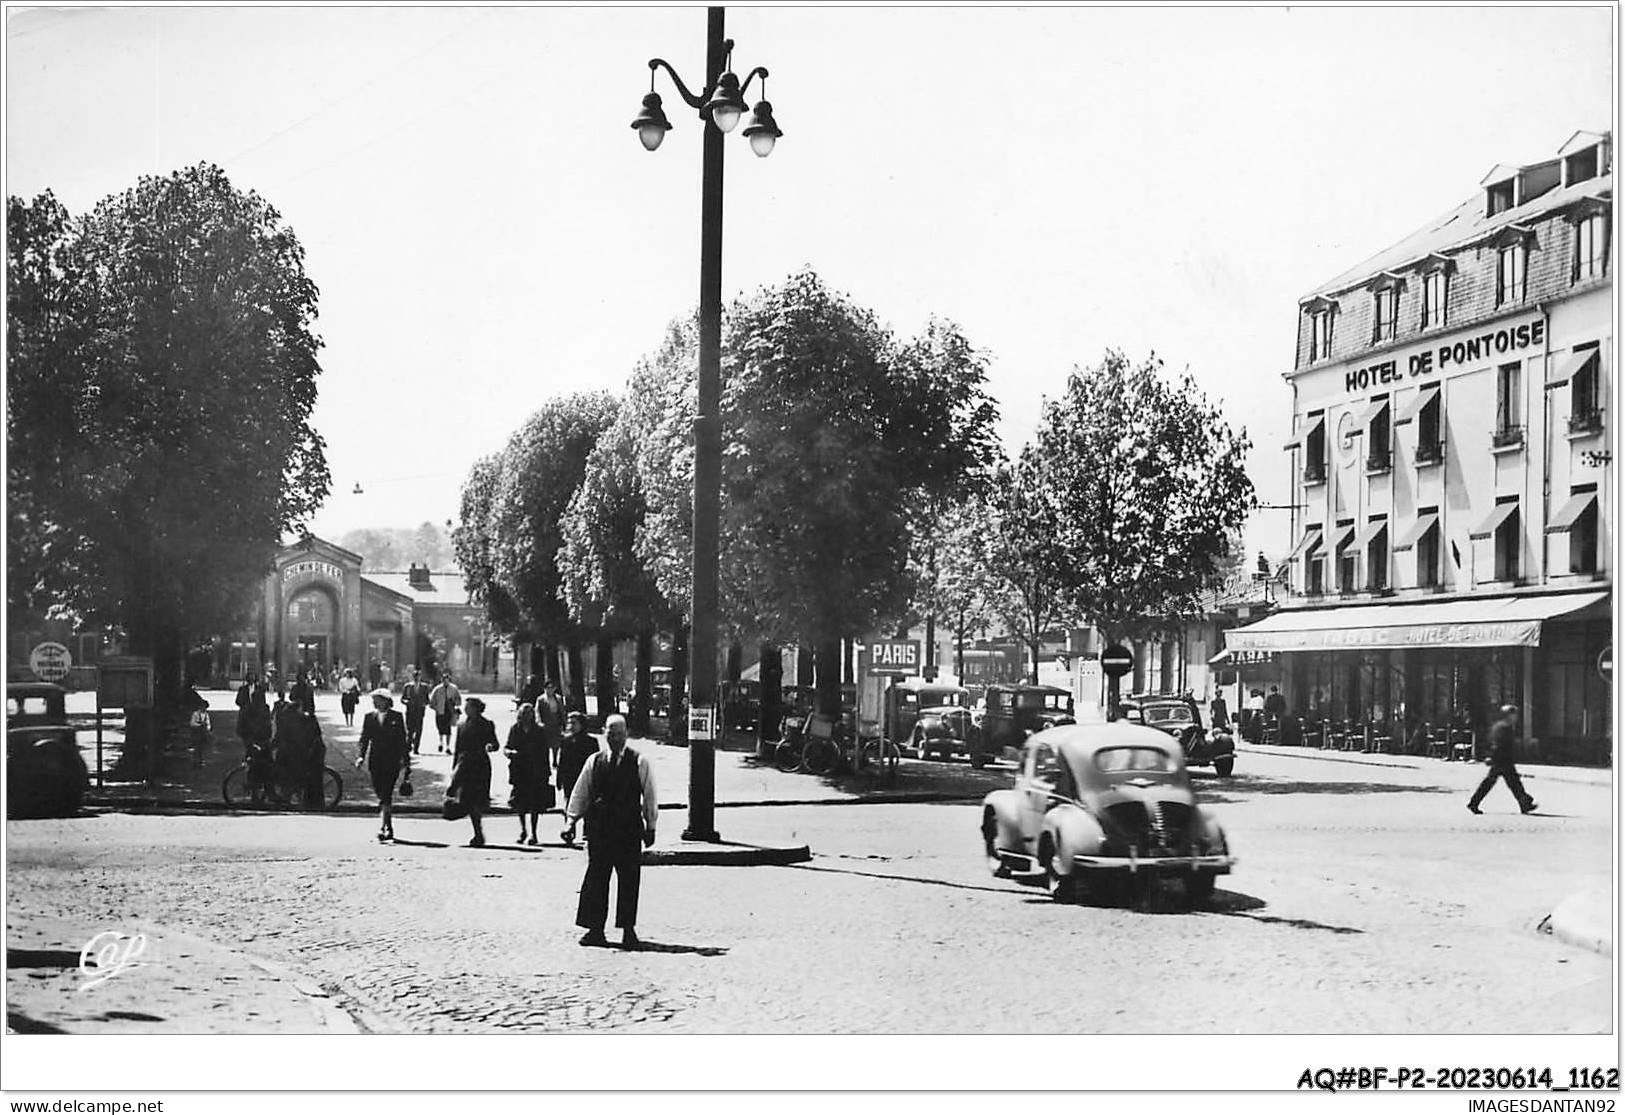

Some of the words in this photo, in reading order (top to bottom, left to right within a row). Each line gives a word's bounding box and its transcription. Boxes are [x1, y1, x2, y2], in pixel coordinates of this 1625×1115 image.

[1346, 360, 1403, 392] HOTEL
[1409, 351, 1433, 377] DE
[1439, 319, 1544, 369] PONTOISE
[872, 643, 916, 664] PARIS
